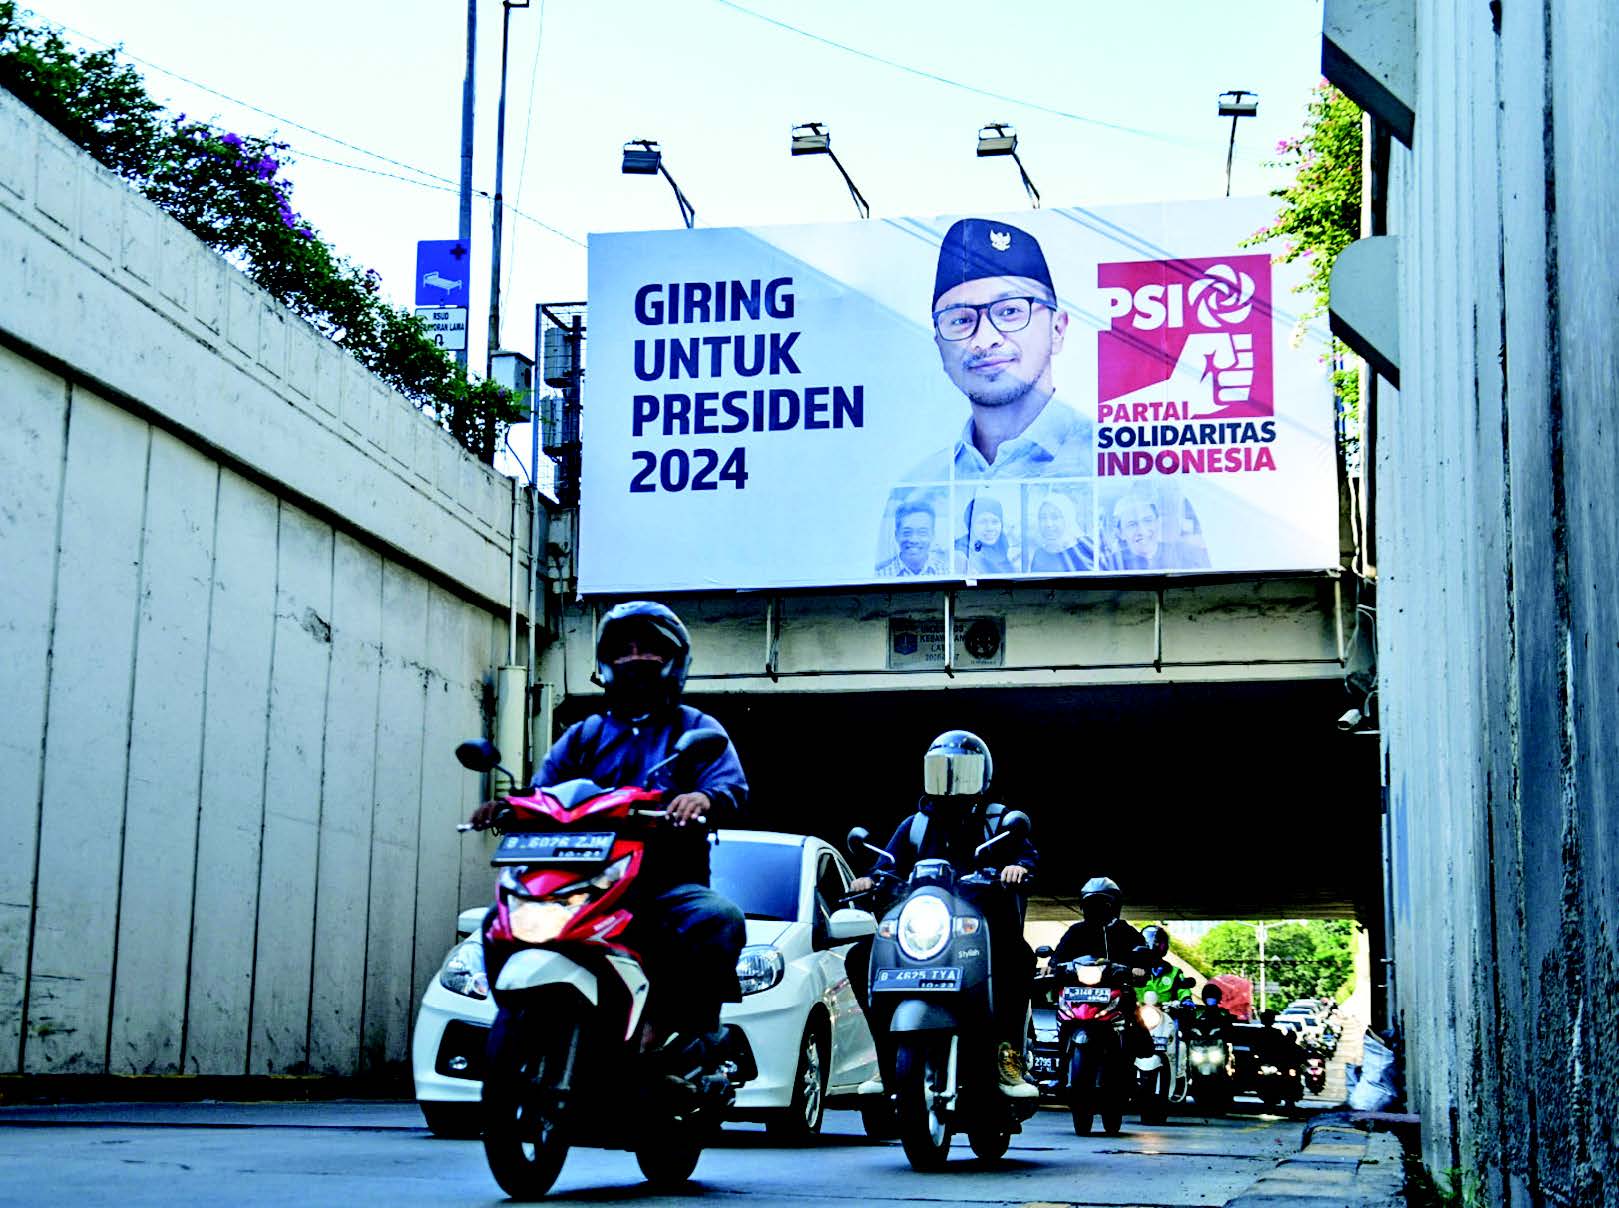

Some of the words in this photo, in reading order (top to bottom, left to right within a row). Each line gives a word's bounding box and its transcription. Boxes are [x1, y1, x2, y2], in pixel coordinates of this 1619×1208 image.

[634, 277, 795, 326] GIRING
[1098, 284, 1184, 331] PSI
[433, 312, 449, 321] RSUD
[449, 322, 464, 331] LAMA
[634, 332, 802, 381] UNTUK
[632, 385, 864, 437] PRESIDEN
[1098, 401, 1189, 423] PARTAI
[1098, 420, 1276, 449] SOLIDARITAS
[629, 447, 749, 493] 2024
[1098, 446, 1276, 476] INDONESIA
[920, 634, 965, 643] KEBAYAN
[880, 972, 889, 981] B
[932, 970, 956, 980] TYA
